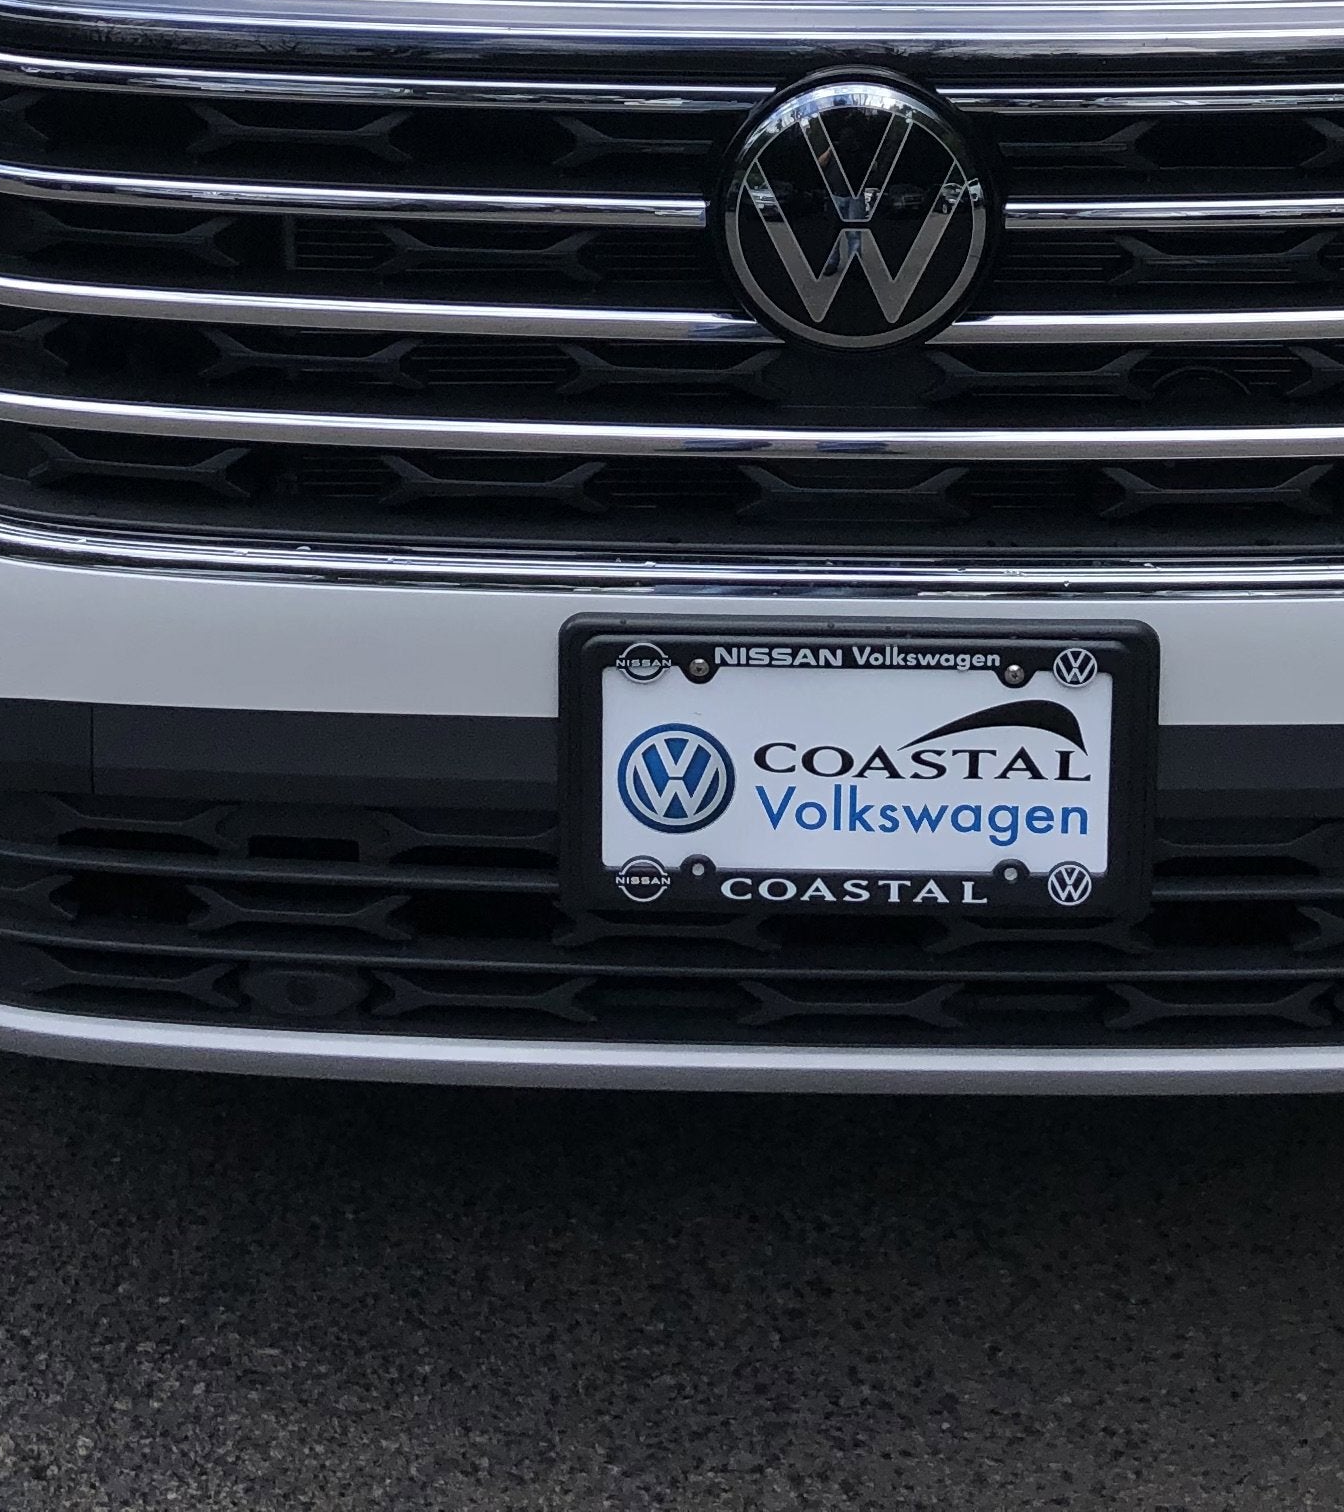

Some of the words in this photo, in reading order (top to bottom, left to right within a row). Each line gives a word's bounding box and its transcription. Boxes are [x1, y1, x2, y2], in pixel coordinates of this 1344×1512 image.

[616, 657, 672, 668] NISSAN
[714, 646, 842, 667] NISSAN
[853, 645, 1001, 671] Volkswagen
[754, 742, 1091, 781] COASTAL
[756, 784, 1088, 846] Volkswagen
[616, 875, 671, 886] NISSAN
[721, 877, 988, 904] COASTAL
